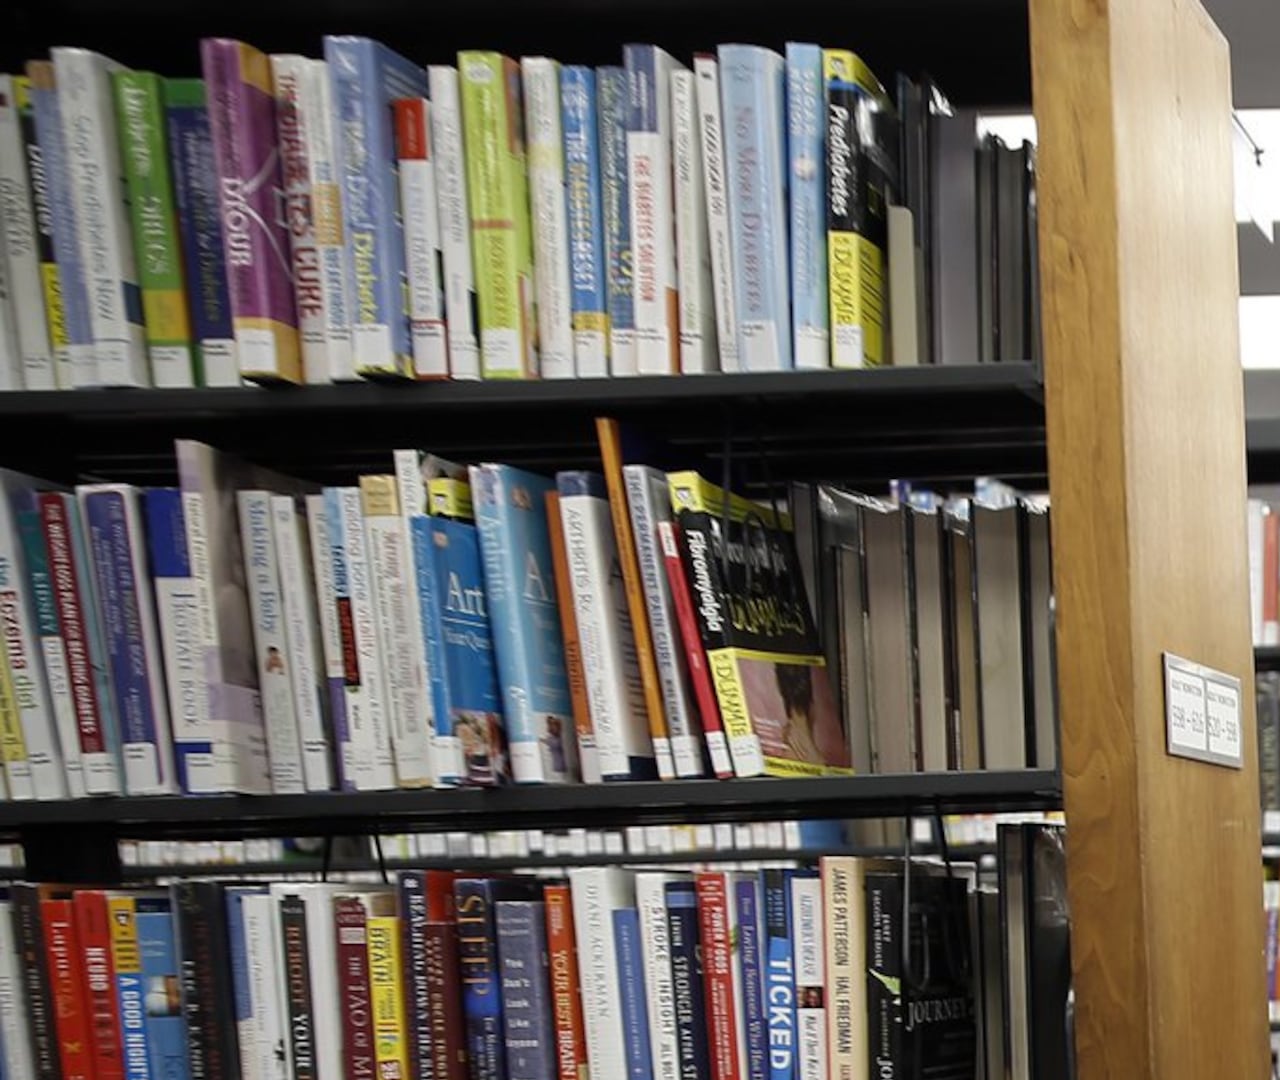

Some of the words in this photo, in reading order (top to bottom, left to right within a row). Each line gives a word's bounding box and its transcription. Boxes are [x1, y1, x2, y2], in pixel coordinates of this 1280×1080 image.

[566, 133, 587, 162] THE
[829, 105, 852, 217] Prediabetes
[295, 247, 323, 318] CURE
[572, 242, 594, 292] RESET
[684, 529, 724, 632] Fibromyalgia
[49, 919, 73, 978] Lupus
[651, 907, 668, 961] STROKE
[832, 906, 850, 966] PATTERSON
[119, 976, 137, 984] A
[552, 949, 569, 990] YOUR
[835, 976, 850, 996] HAL
[121, 990, 142, 1028] GOOD
[556, 992, 573, 1029] BEST
[769, 956, 792, 1070] TICKED
[836, 1000, 852, 1054] FRIEDMAN
[293, 1013, 312, 1069] YOUR
[558, 1030, 575, 1076] BRAIN
